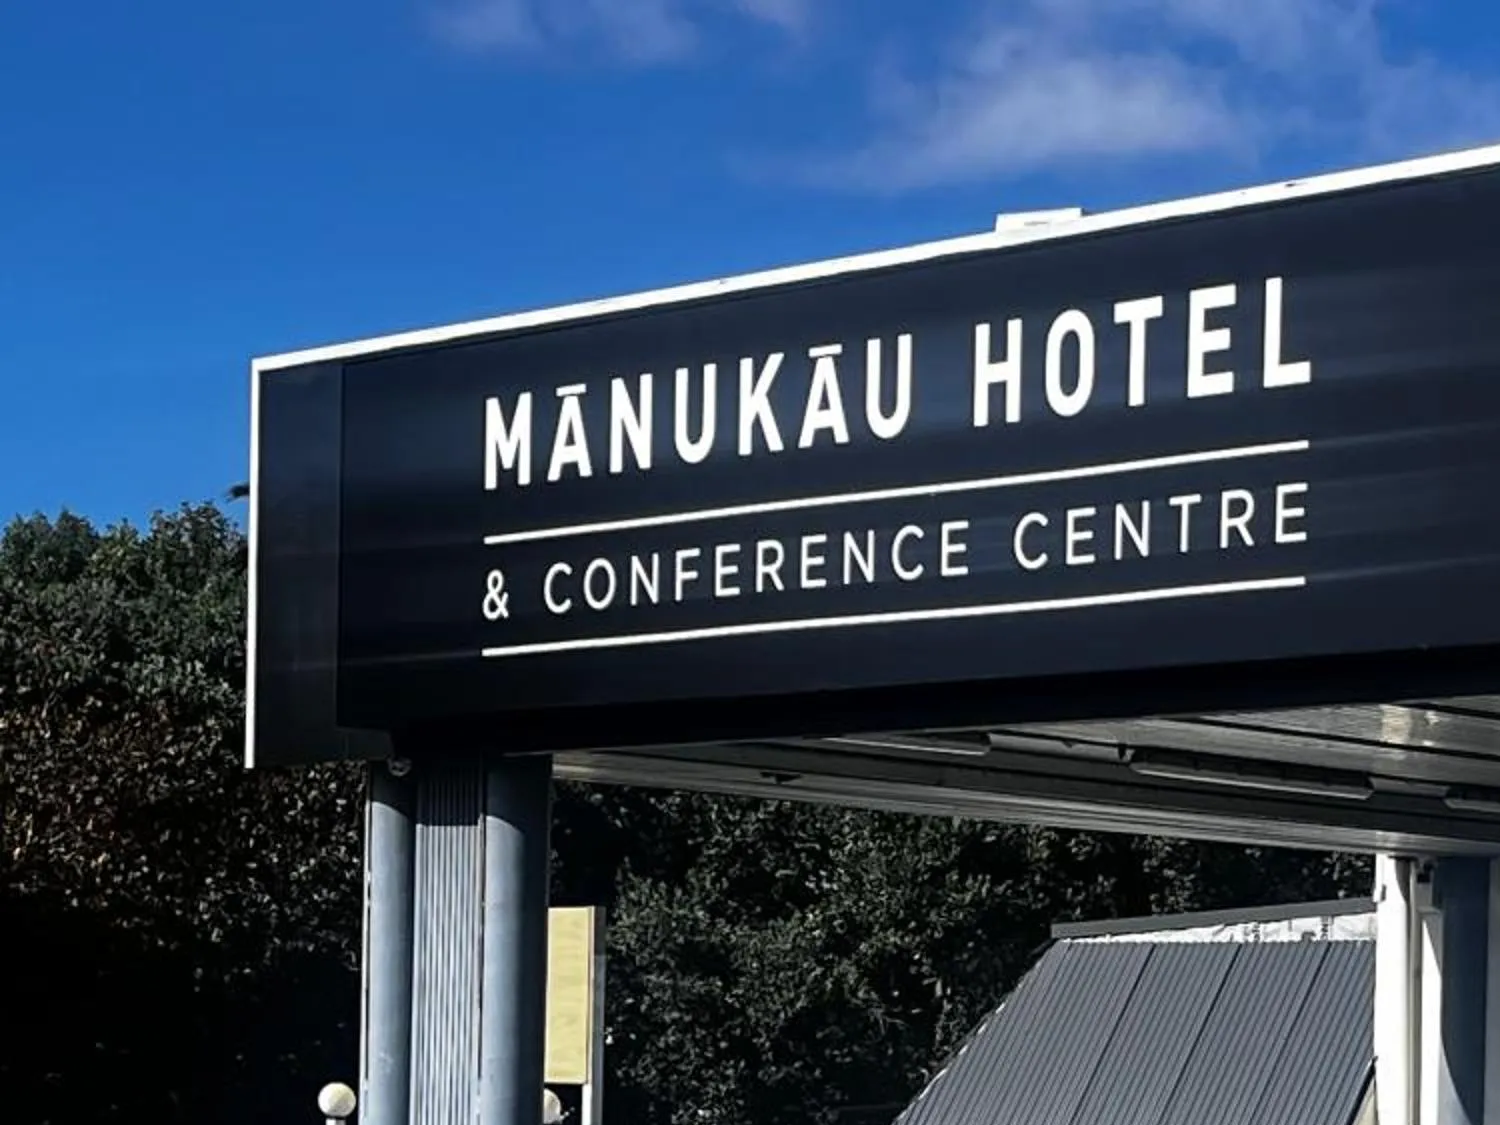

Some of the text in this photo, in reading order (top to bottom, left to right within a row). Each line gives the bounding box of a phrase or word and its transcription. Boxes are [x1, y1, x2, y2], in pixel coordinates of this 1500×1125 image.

[483, 276, 1313, 490] MĀNUKĀU HOTEL
[482, 482, 1310, 621] & CONFERENCE CENTRE
